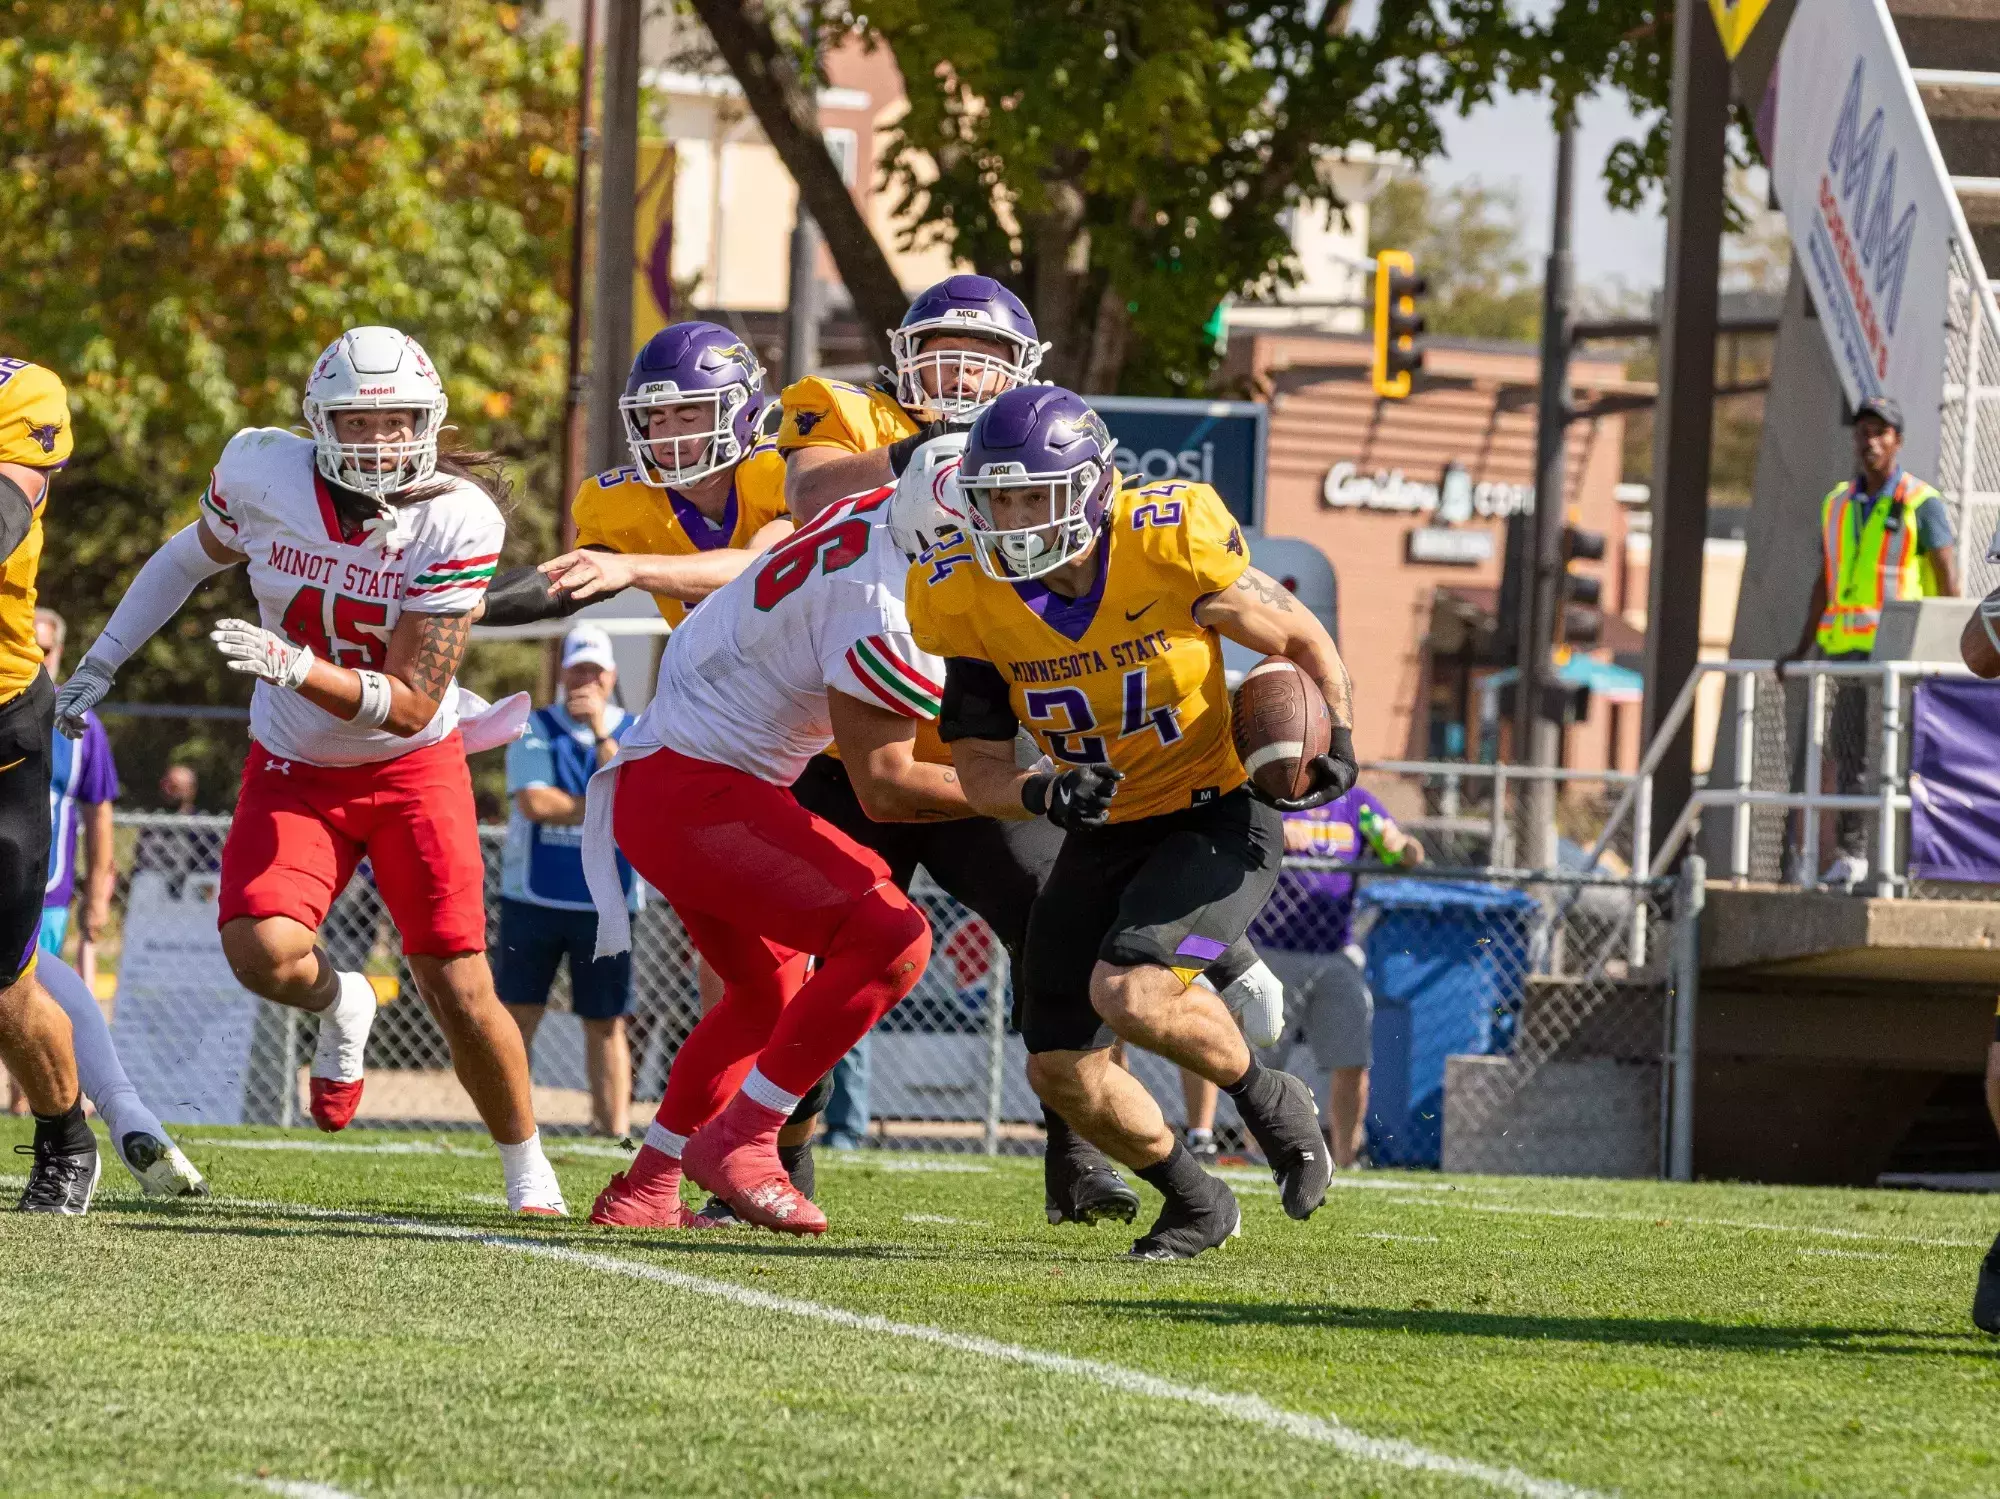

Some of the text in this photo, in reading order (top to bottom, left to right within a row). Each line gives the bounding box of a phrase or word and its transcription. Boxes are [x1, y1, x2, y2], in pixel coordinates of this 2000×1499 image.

[956, 309, 978, 318] MSU
[360, 386, 396, 395] Riddell
[645, 383, 664, 393] MSU
[598, 466, 641, 489] 5
[989, 464, 1012, 475] MSU
[1114, 441, 1214, 487] epsi
[1132, 483, 1187, 531] 24
[267, 541, 339, 584] MINOT
[919, 531, 974, 586] 24
[280, 584, 388, 673] 45
[1008, 629, 1172, 683] MINNESOTA STATE
[1023, 667, 1183, 766] 24
[1200, 790, 1211, 801] M
